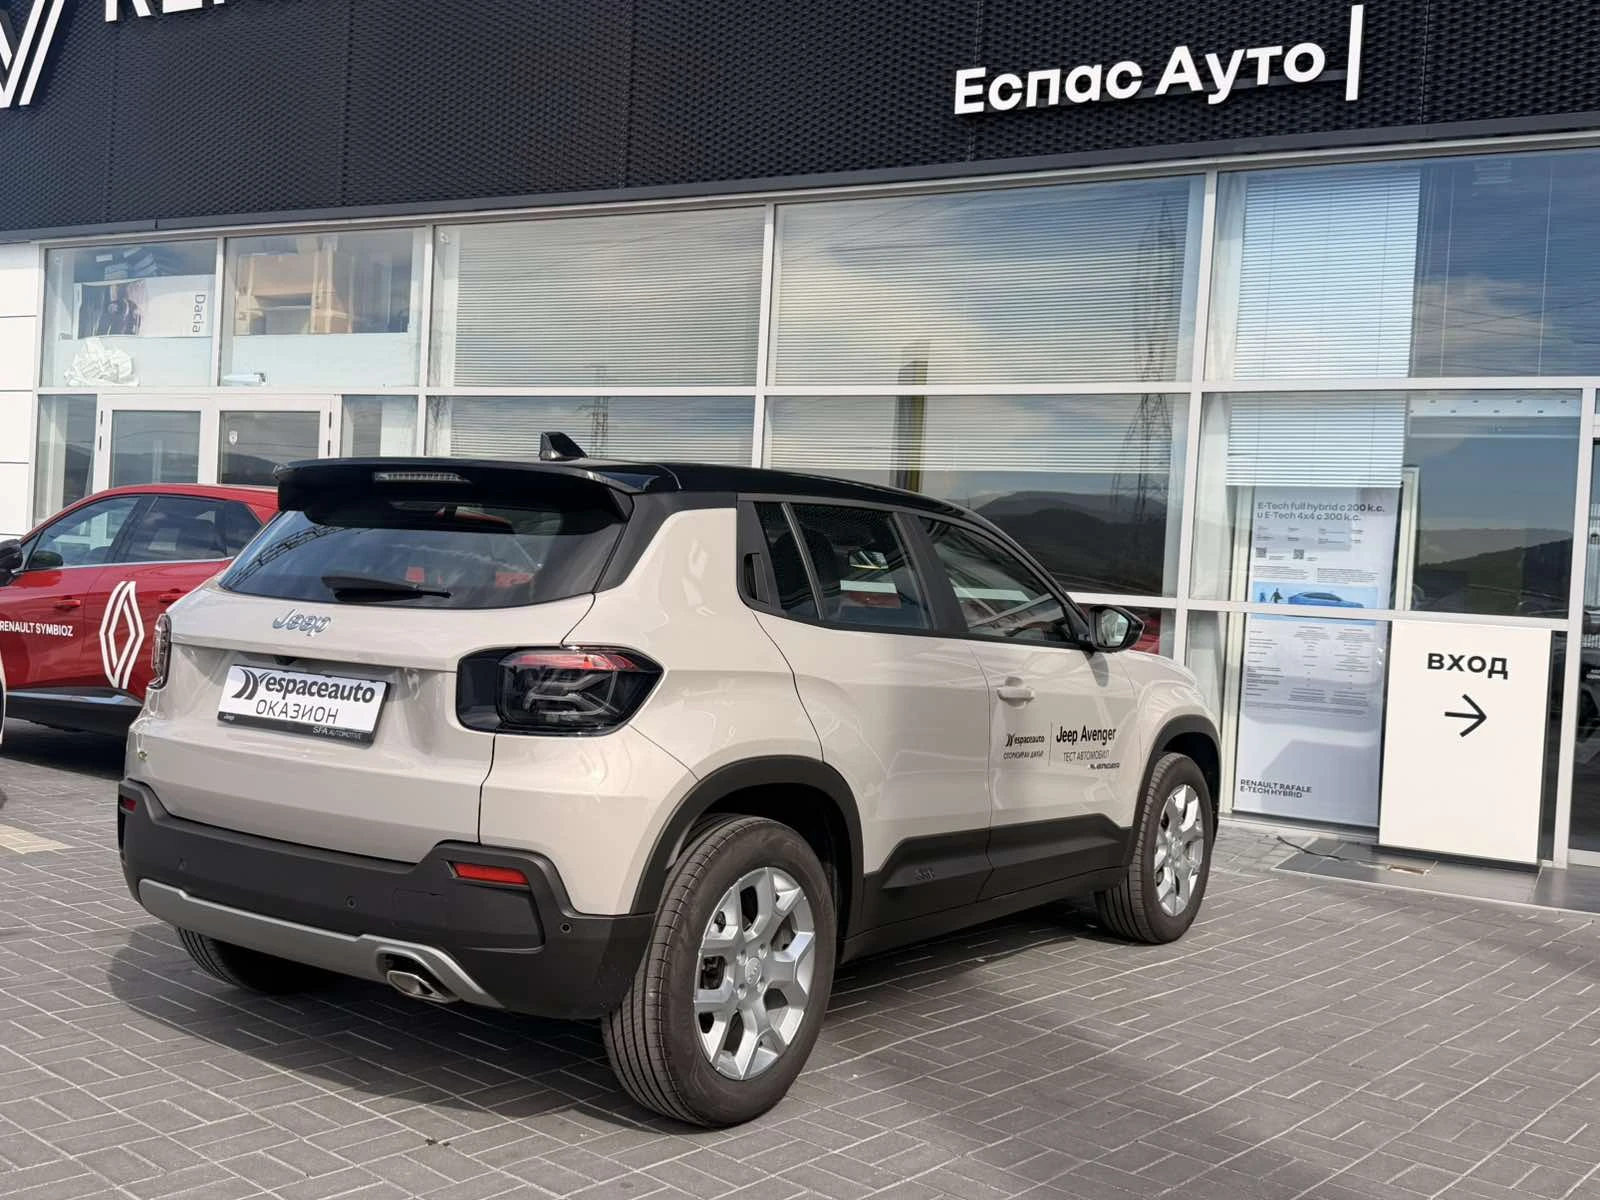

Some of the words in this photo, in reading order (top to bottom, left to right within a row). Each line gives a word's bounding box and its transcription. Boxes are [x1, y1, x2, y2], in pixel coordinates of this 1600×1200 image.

[954, 60, 1143, 115] Еспас
[1155, 42, 1326, 105] Ауто
[192, 294, 206, 333] Dacia
[1257, 502, 1290, 510] E-Tech
[1291, 502, 1306, 511] full
[1307, 503, 1339, 512] hybrid
[1346, 503, 1366, 512] 200
[1265, 512, 1296, 520] E-Tech
[1324, 513, 1343, 521] 300
[0, 621, 35, 633] RENAULT
[36, 623, 73, 637] SYMBIOZ
[272, 608, 331, 636] Jeep
[1427, 653, 1508, 680] ВХОД
[265, 673, 376, 703] espaceauto
[256, 700, 340, 724] ОКАЗИОН
[1056, 726, 1078, 745] Jeep
[1080, 725, 1117, 746] Avenger
[1064, 752, 1076, 762] ТЕСТ
[1240, 779, 1278, 789] RENAULT
[1280, 783, 1312, 793] RAFALE
[1240, 786, 1270, 795] E-TECH
[1271, 789, 1303, 798] HYBRID
